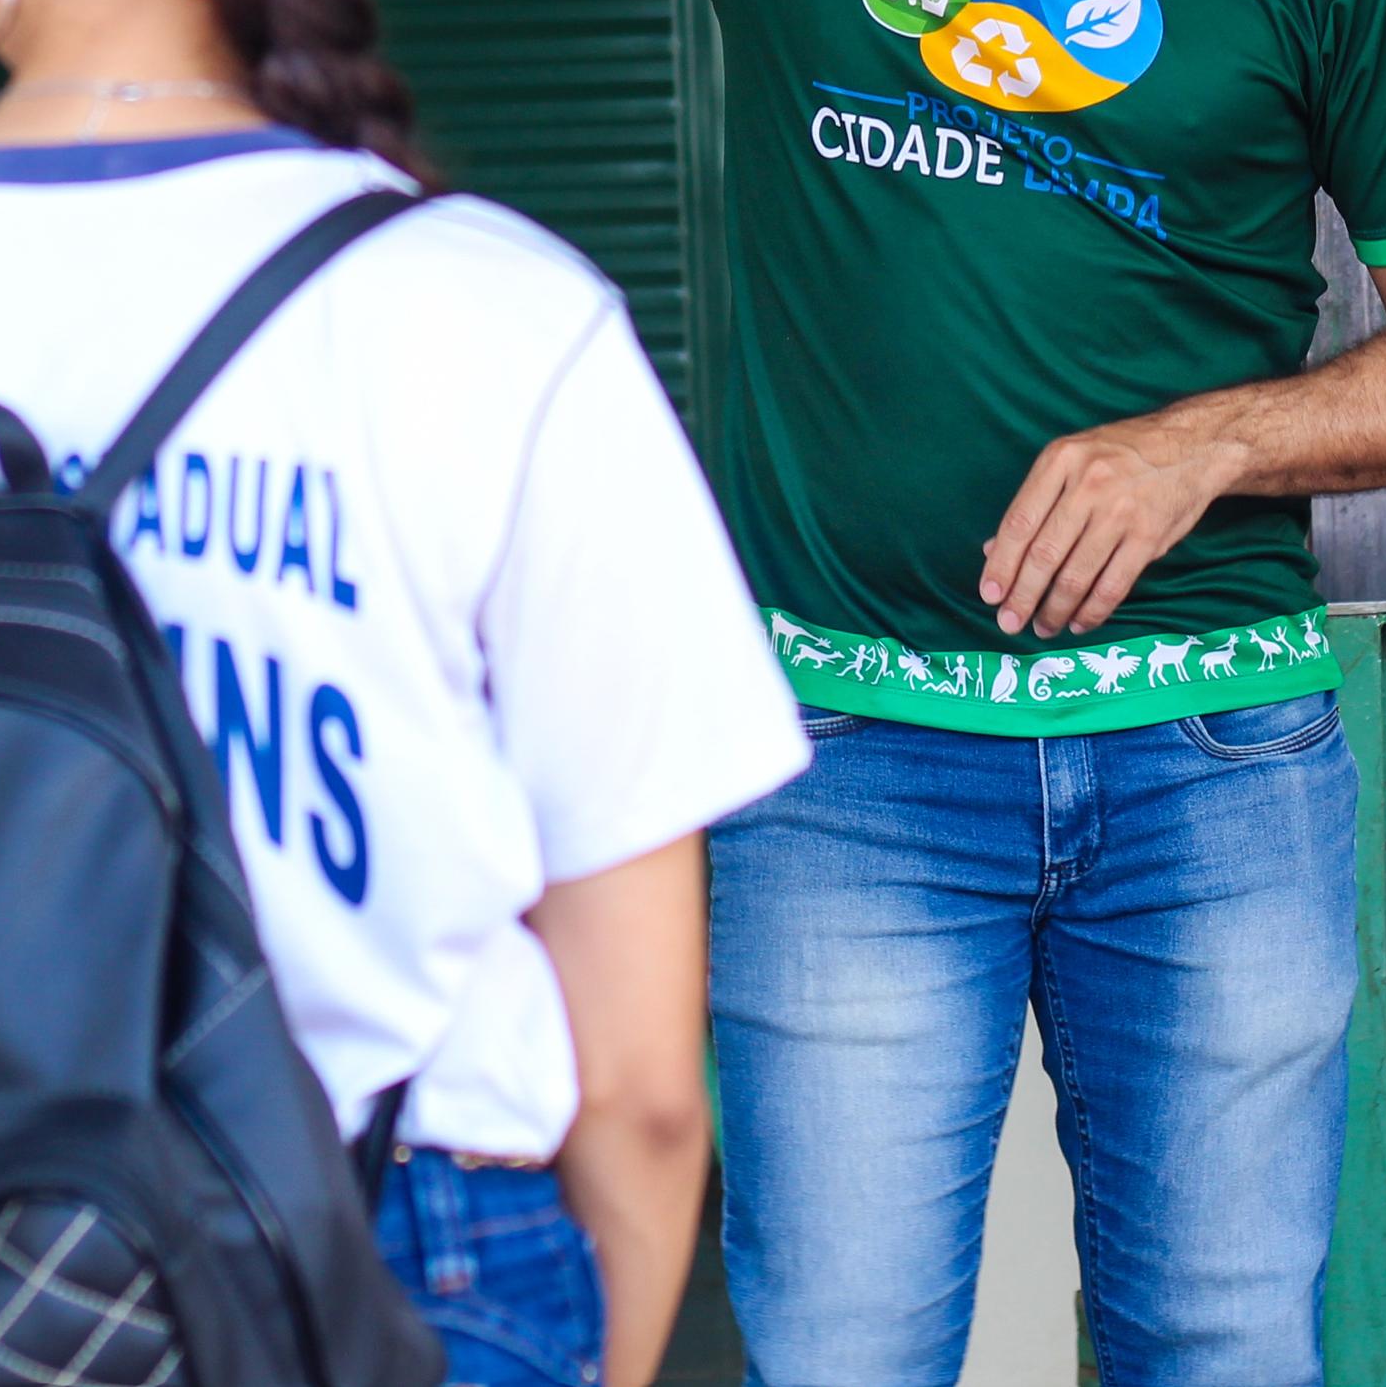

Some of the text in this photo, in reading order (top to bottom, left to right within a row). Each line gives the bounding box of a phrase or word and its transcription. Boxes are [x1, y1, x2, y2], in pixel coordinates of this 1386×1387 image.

[811, 106, 1005, 185] CIDADE
[907, 91, 1075, 166] PROJETO
[59, 452, 358, 612] ADUAL
